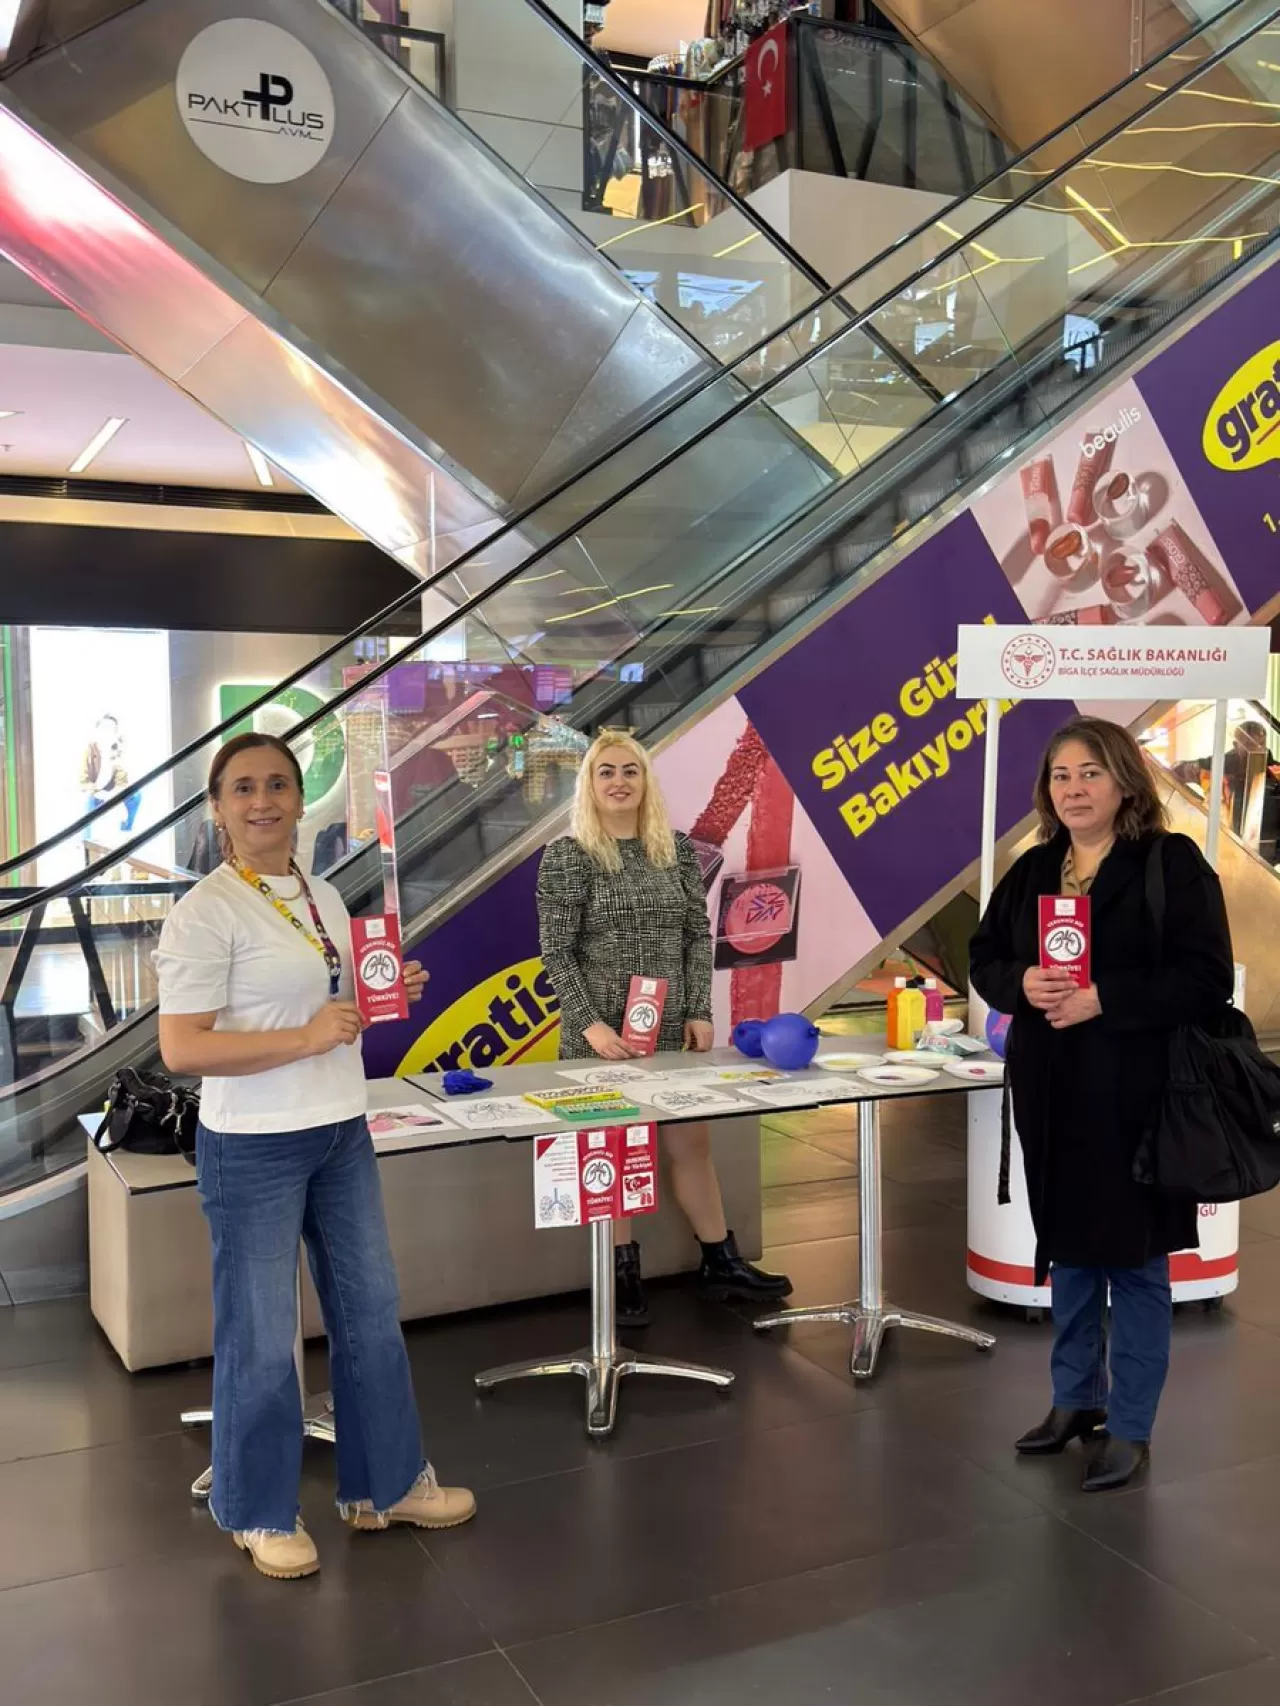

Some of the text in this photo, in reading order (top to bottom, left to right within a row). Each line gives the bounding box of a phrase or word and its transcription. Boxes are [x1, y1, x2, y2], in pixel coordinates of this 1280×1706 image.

[1080, 406, 1142, 459] beaulis
[1217, 358, 1280, 463] gra
[1059, 646, 1227, 662] T.C. SAĞLIK BAKANLIĞI
[1099, 667, 1129, 676] SAĞLIK
[811, 712, 900, 792] Size
